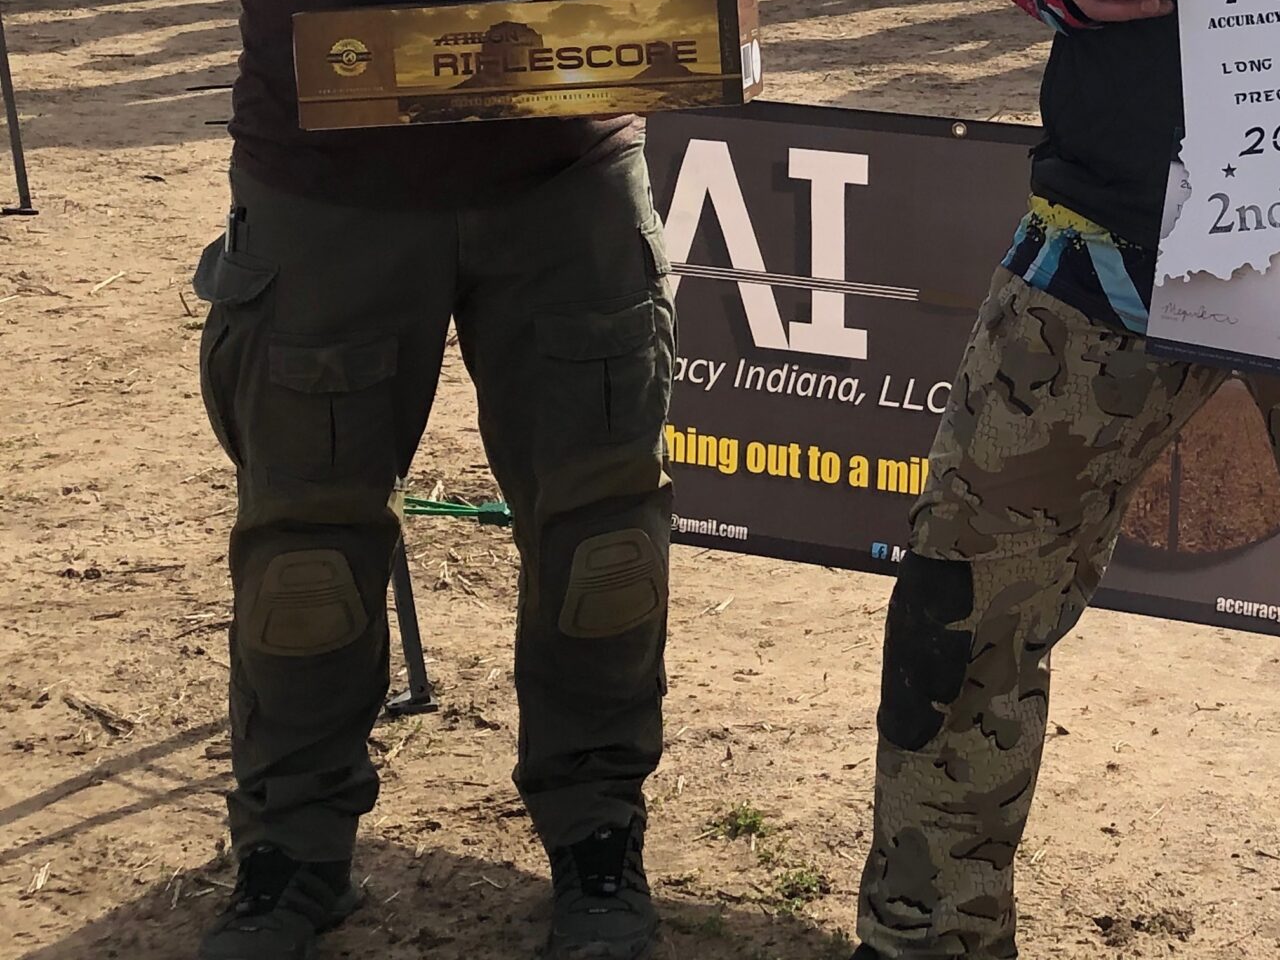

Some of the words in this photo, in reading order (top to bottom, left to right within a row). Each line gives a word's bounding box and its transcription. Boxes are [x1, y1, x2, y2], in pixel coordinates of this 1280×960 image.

[433, 39, 699, 77] RIFLESCOPE
[1221, 58, 1273, 75] LONG
[664, 138, 868, 360] AI
[673, 355, 727, 392] acy
[733, 357, 866, 407] Indiana,
[877, 374, 952, 414] LLC
[665, 424, 739, 475] hing
[746, 441, 802, 479] out
[807, 445, 841, 484] to
[848, 454, 869, 488] a
[671, 513, 749, 541] @gmail.com
